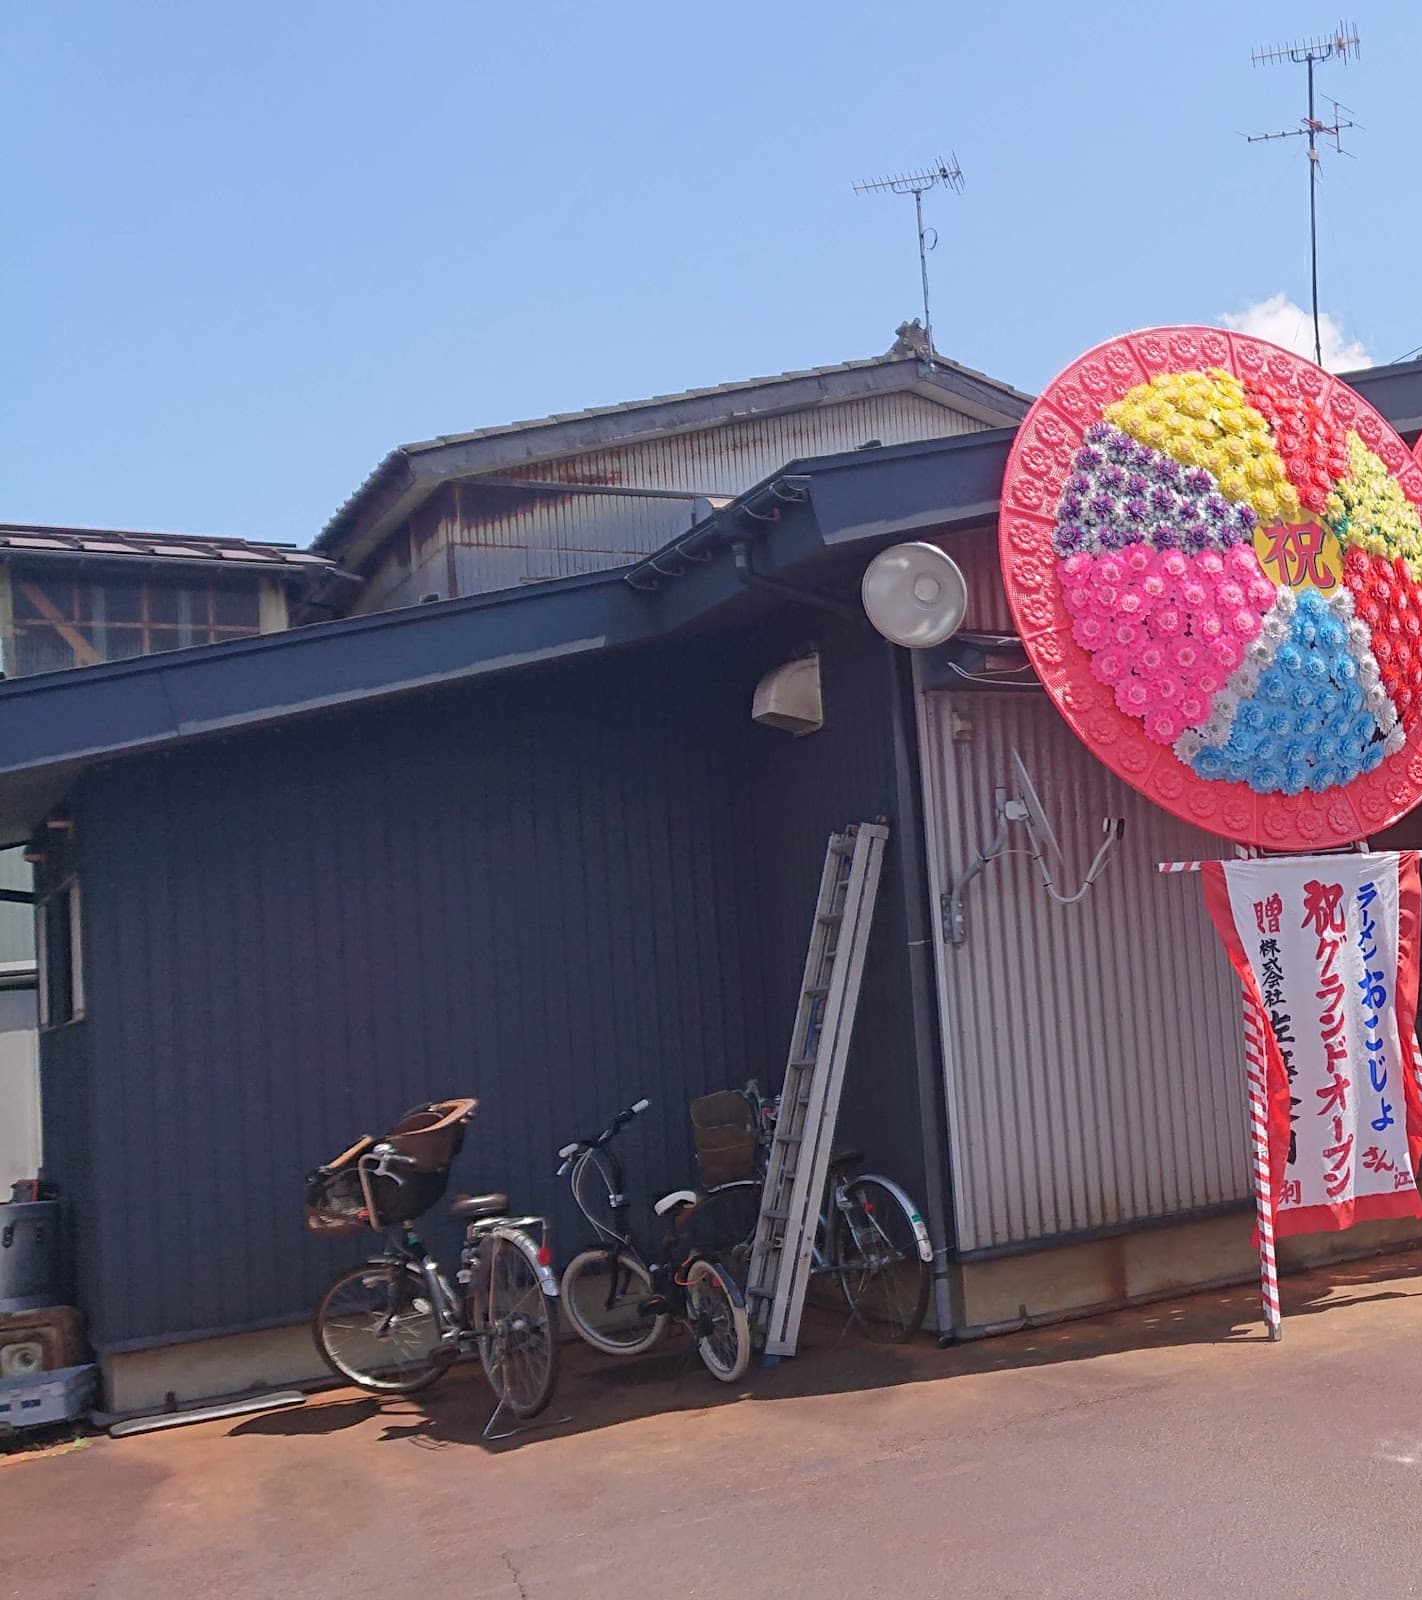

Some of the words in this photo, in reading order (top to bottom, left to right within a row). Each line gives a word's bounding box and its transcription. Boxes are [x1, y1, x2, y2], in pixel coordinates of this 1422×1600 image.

[1263, 518, 1336, 588] 祝
[1253, 892, 1283, 934] 贈
[1301, 879, 1354, 1198] 祝グランドオープン
